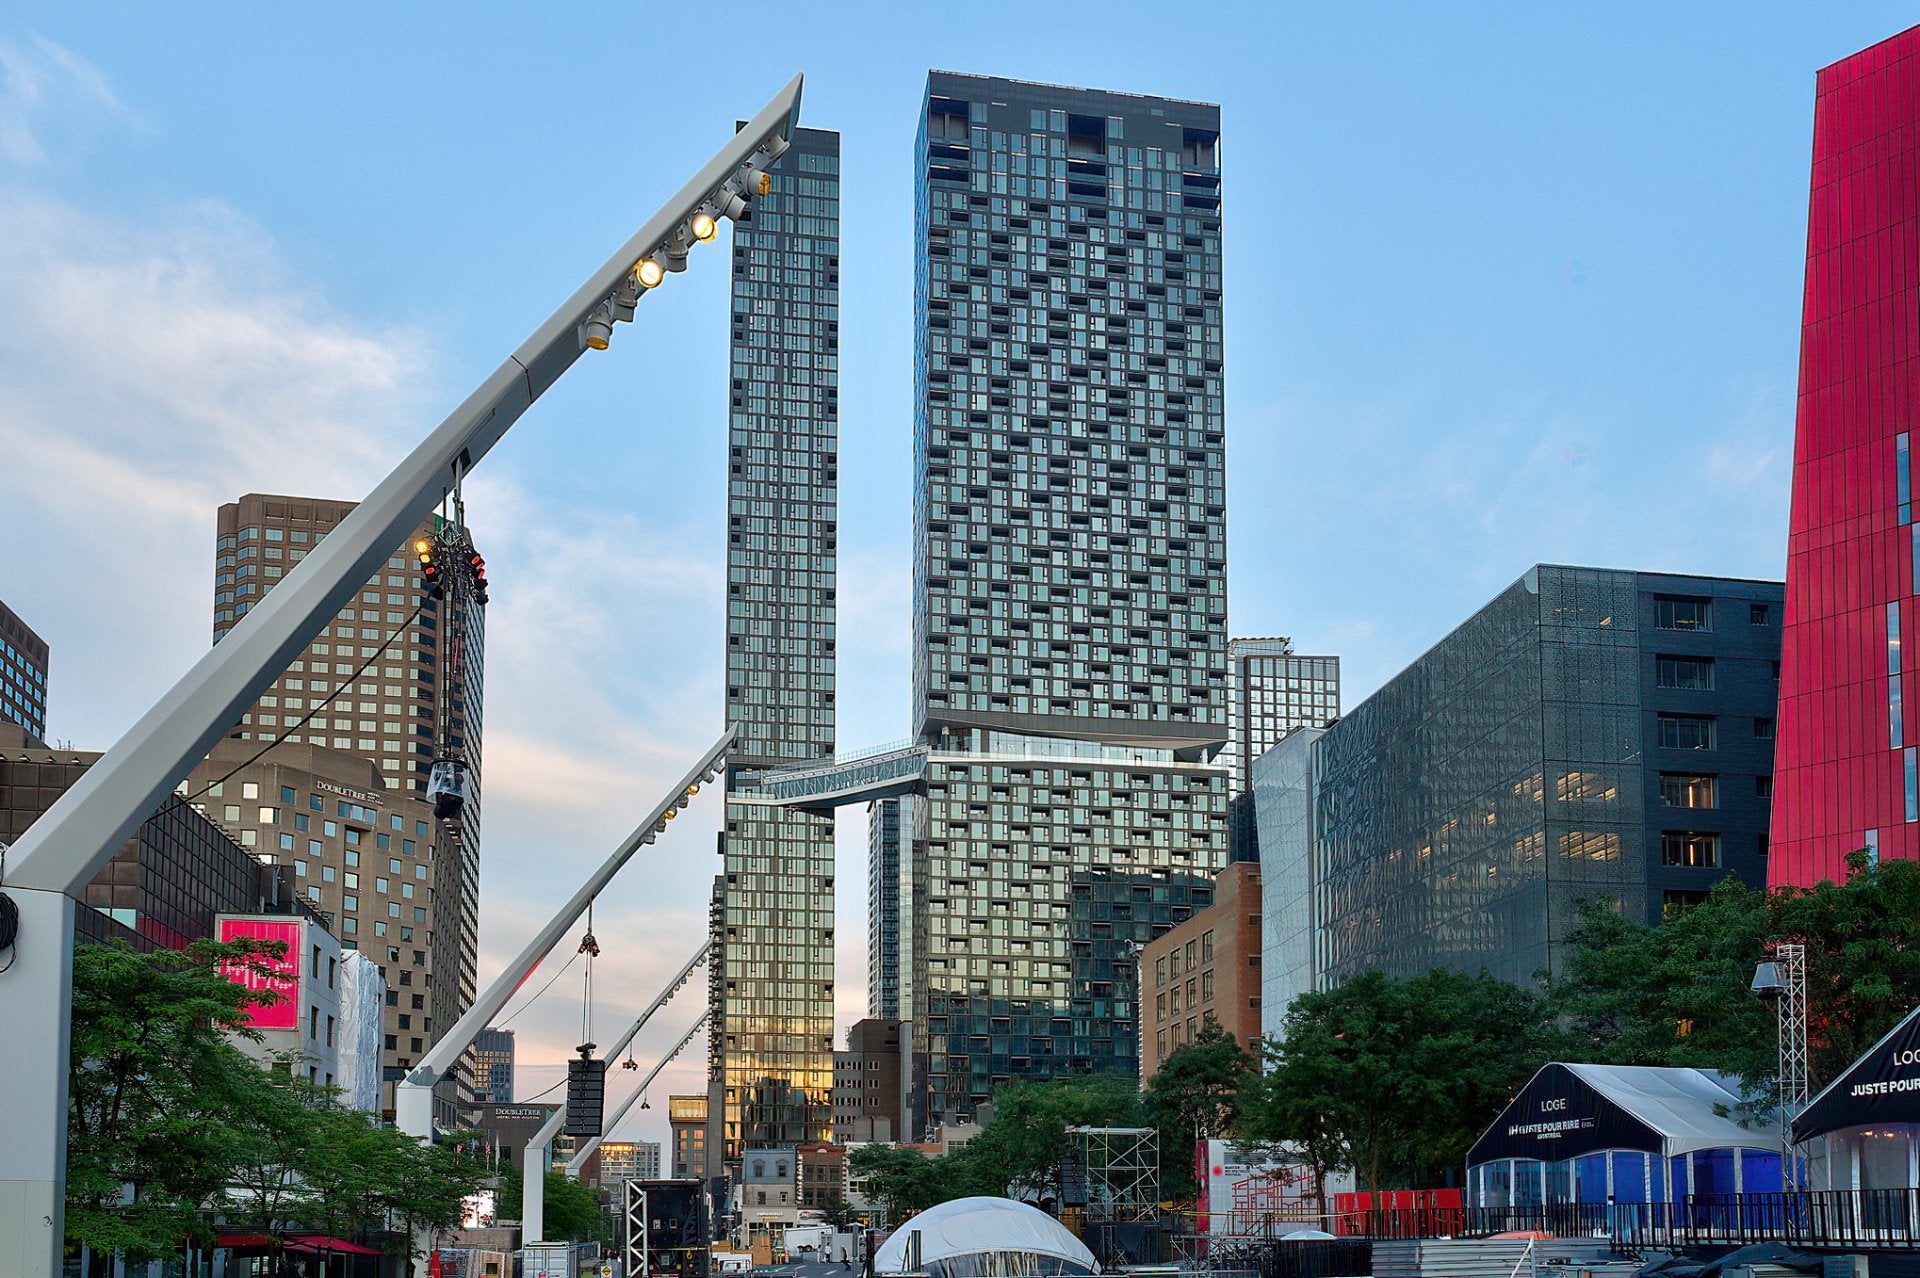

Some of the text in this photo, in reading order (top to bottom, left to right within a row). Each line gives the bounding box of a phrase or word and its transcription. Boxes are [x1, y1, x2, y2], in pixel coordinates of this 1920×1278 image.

[1851, 1078, 1920, 1097] JUSTE POUR
[1541, 1098, 1567, 1112] LOGE
[1542, 1121, 1562, 1133] POUR
[1562, 1119, 1580, 1130] RIRE
